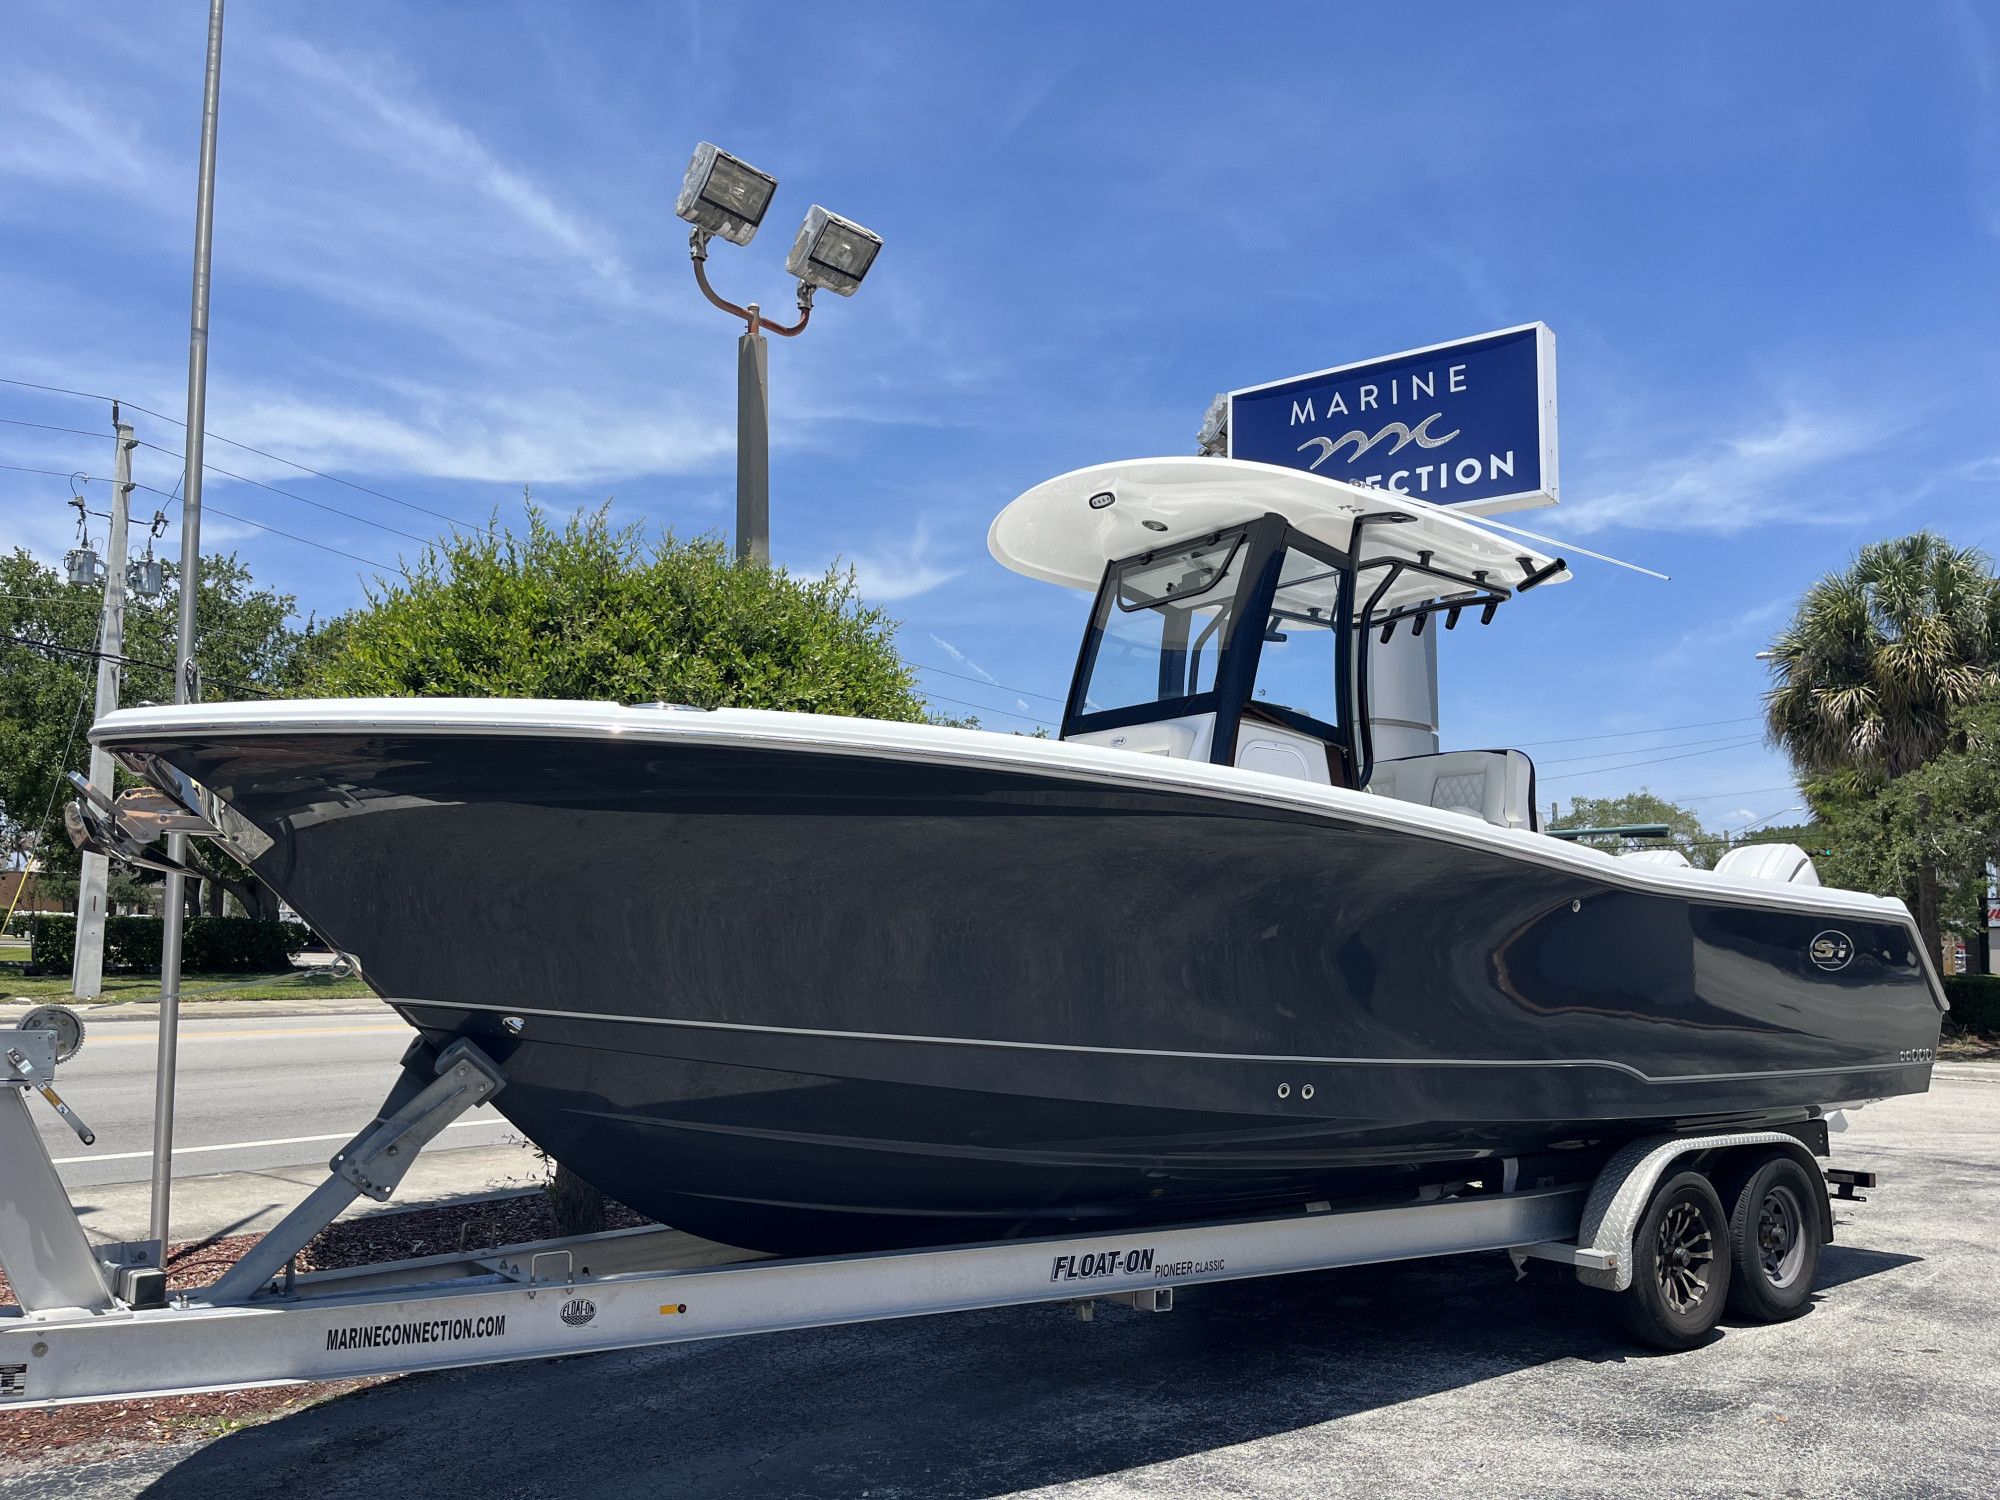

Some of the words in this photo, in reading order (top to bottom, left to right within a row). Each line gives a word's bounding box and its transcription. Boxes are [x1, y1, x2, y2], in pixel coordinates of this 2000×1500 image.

[1290, 364, 1467, 426] MARINE
[1051, 1248, 1155, 1281] FLOAT-ON
[1154, 1261, 1193, 1279] PIONEER
[1194, 1259, 1225, 1276] CLASSIC
[561, 1299, 595, 1317] FLOAT-ON
[326, 1315, 506, 1351] MARINECONNECTION.COM
